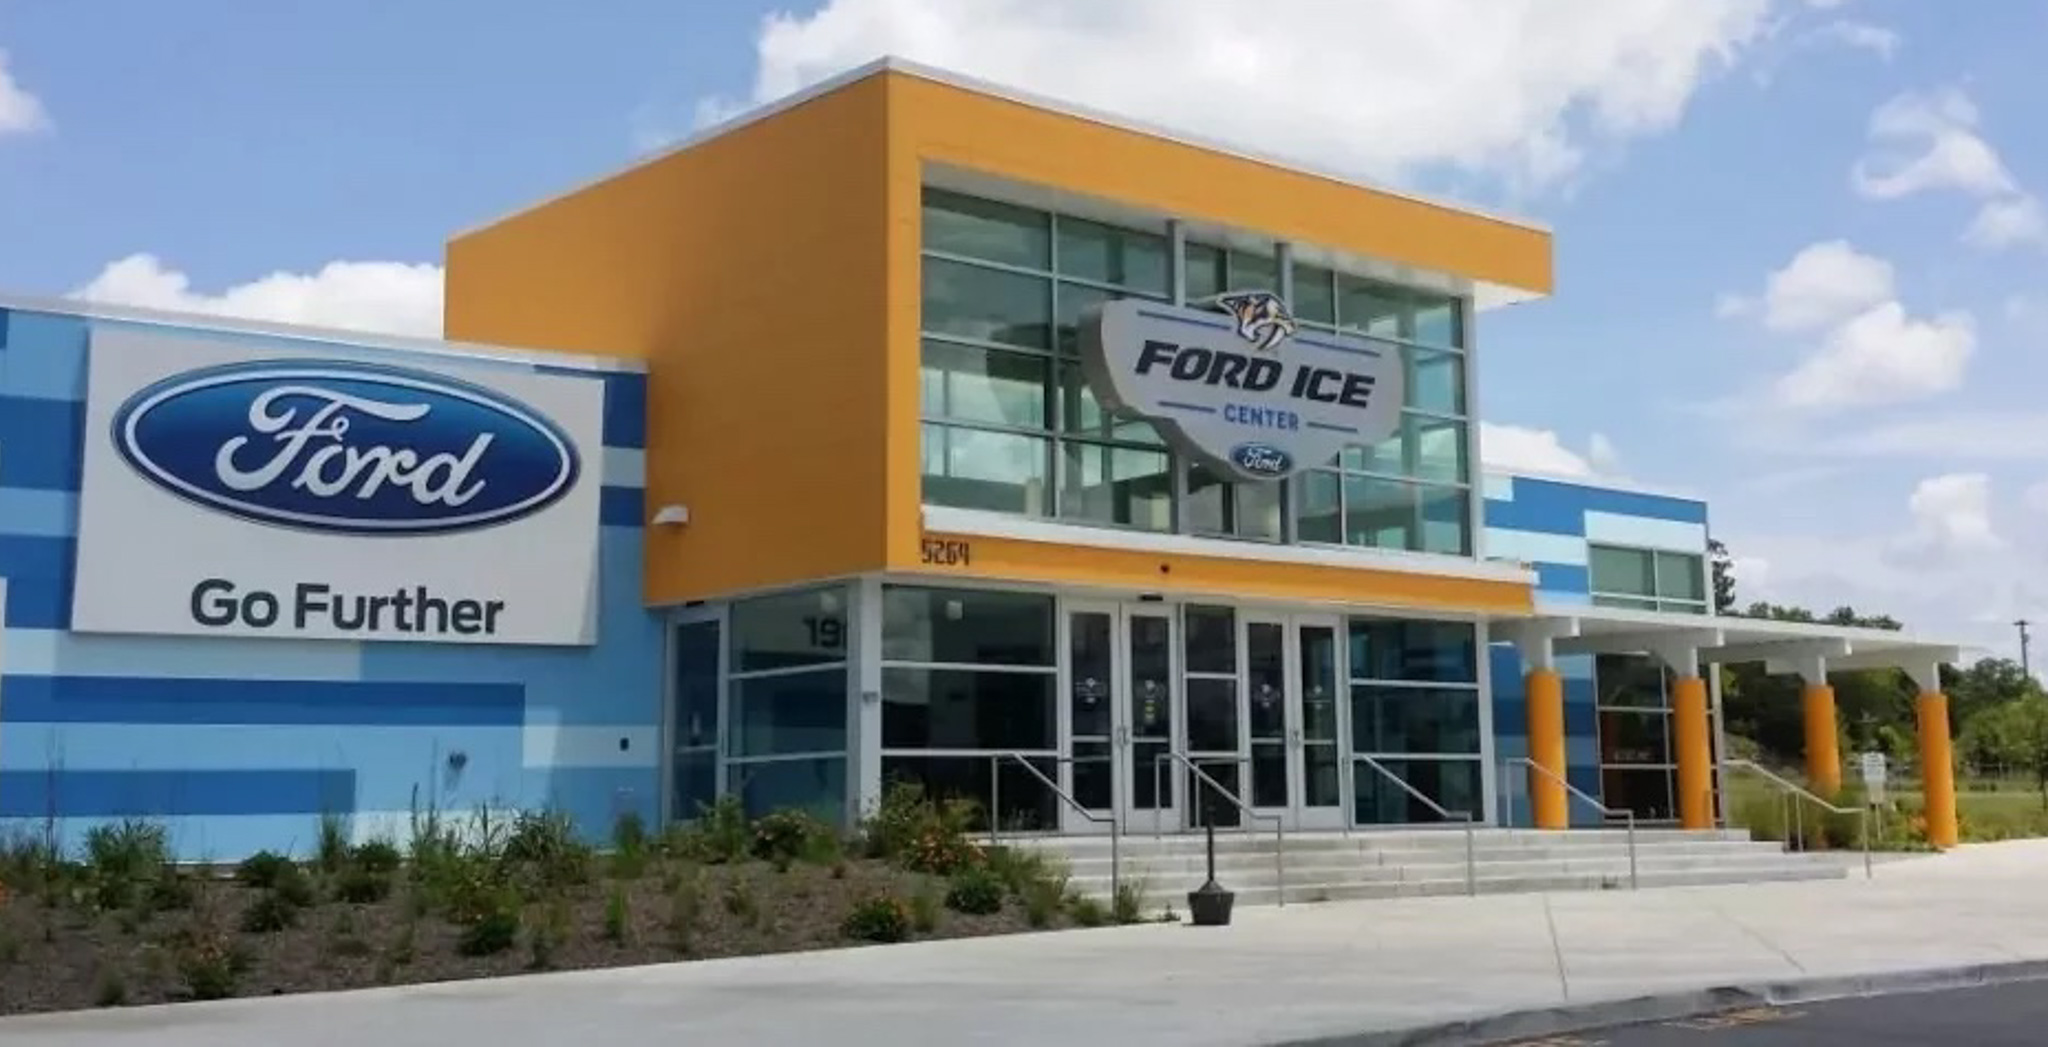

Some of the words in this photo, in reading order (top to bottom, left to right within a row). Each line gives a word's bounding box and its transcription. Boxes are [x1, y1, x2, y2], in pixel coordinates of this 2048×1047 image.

[1135, 339, 1283, 391] FORD
[1290, 366, 1376, 408] ICE
[1223, 404, 1300, 431] CENTER
[215, 386, 494, 508] Ford
[1243, 447, 1284, 471] Ford
[921, 538, 970, 567] 5264
[190, 579, 280, 628] Go
[294, 583, 504, 635] Further
[803, 616, 847, 649] 19
